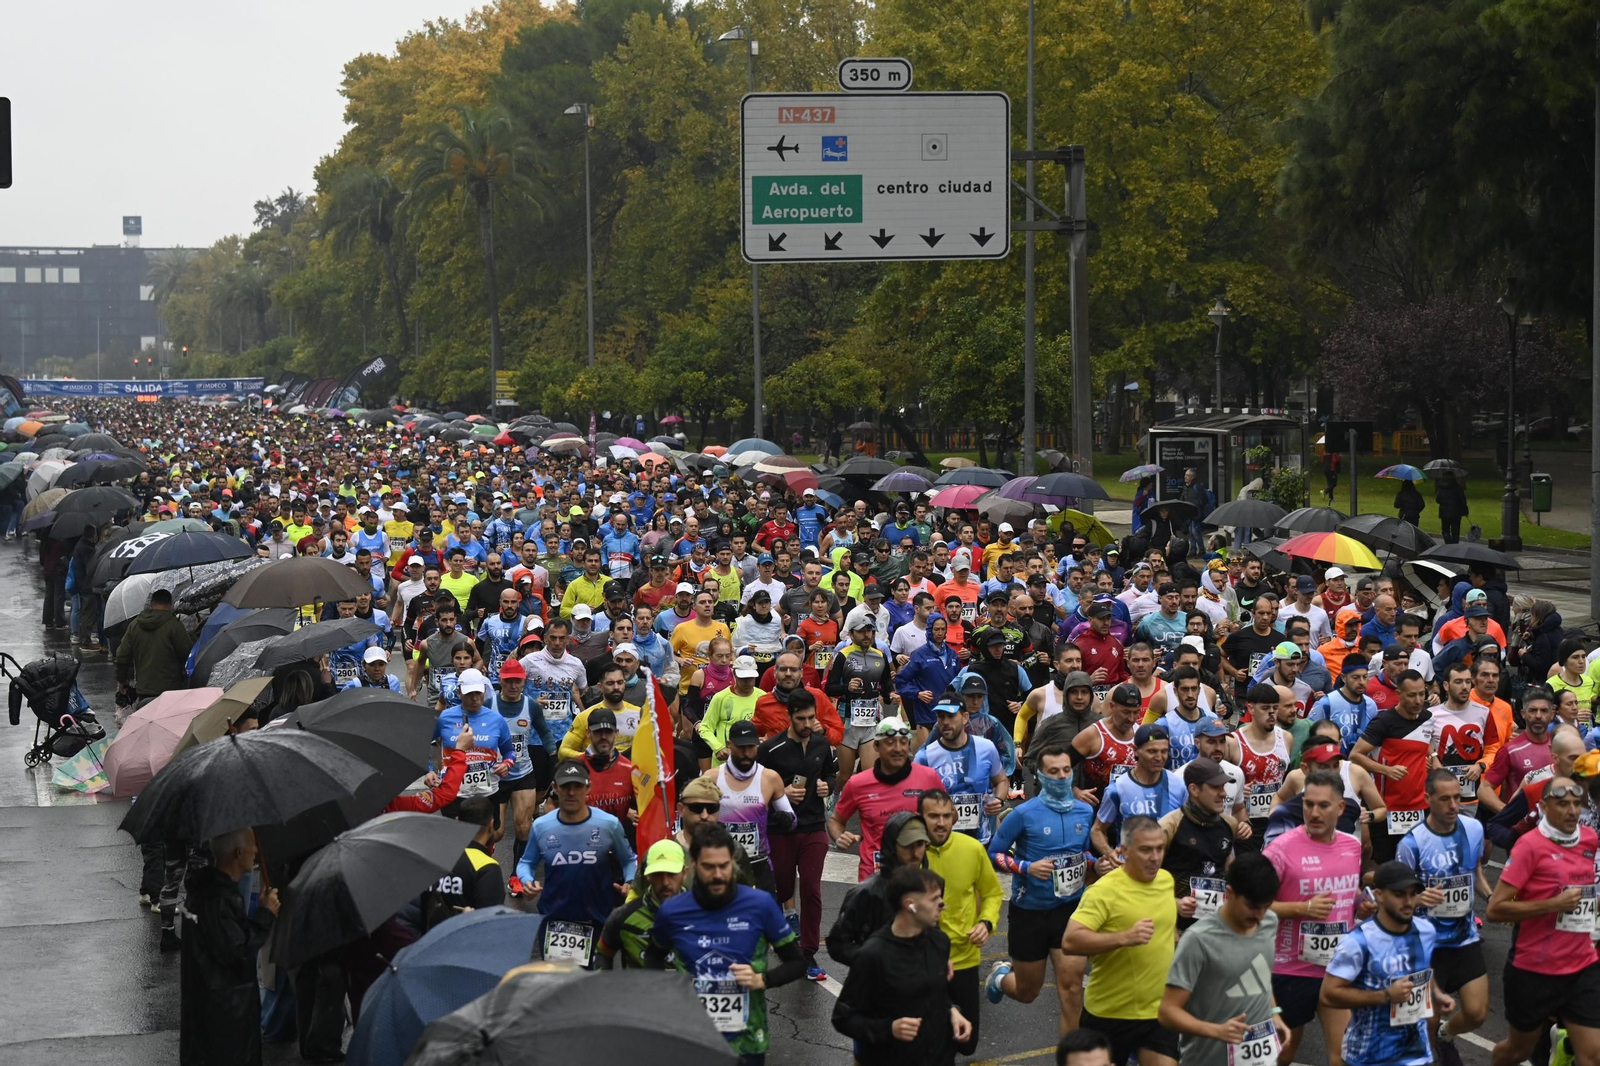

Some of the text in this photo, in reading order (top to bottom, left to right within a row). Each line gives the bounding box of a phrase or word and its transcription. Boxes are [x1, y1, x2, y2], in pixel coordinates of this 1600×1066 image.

[849, 68, 901, 82] 350 m
[781, 108, 832, 122] N-437
[769, 181, 846, 196] Avda. del
[877, 180, 992, 194] centro ciudad
[762, 203, 853, 221] Aeropuerto
[362, 357, 384, 377] POWER
[125, 384, 163, 393] SALIDA
[337, 669, 357, 677] 2901
[855, 708, 876, 718] 3522
[1391, 811, 1420, 822] 3329
[551, 850, 598, 866] ADS
[1301, 856, 1321, 865] ABB
[1058, 865, 1084, 883] 1360
[1204, 892, 1218, 906] 74
[550, 933, 586, 950] 2394
[1280, 919, 1294, 952] Vailla
[1240, 1039, 1272, 1060] 305
